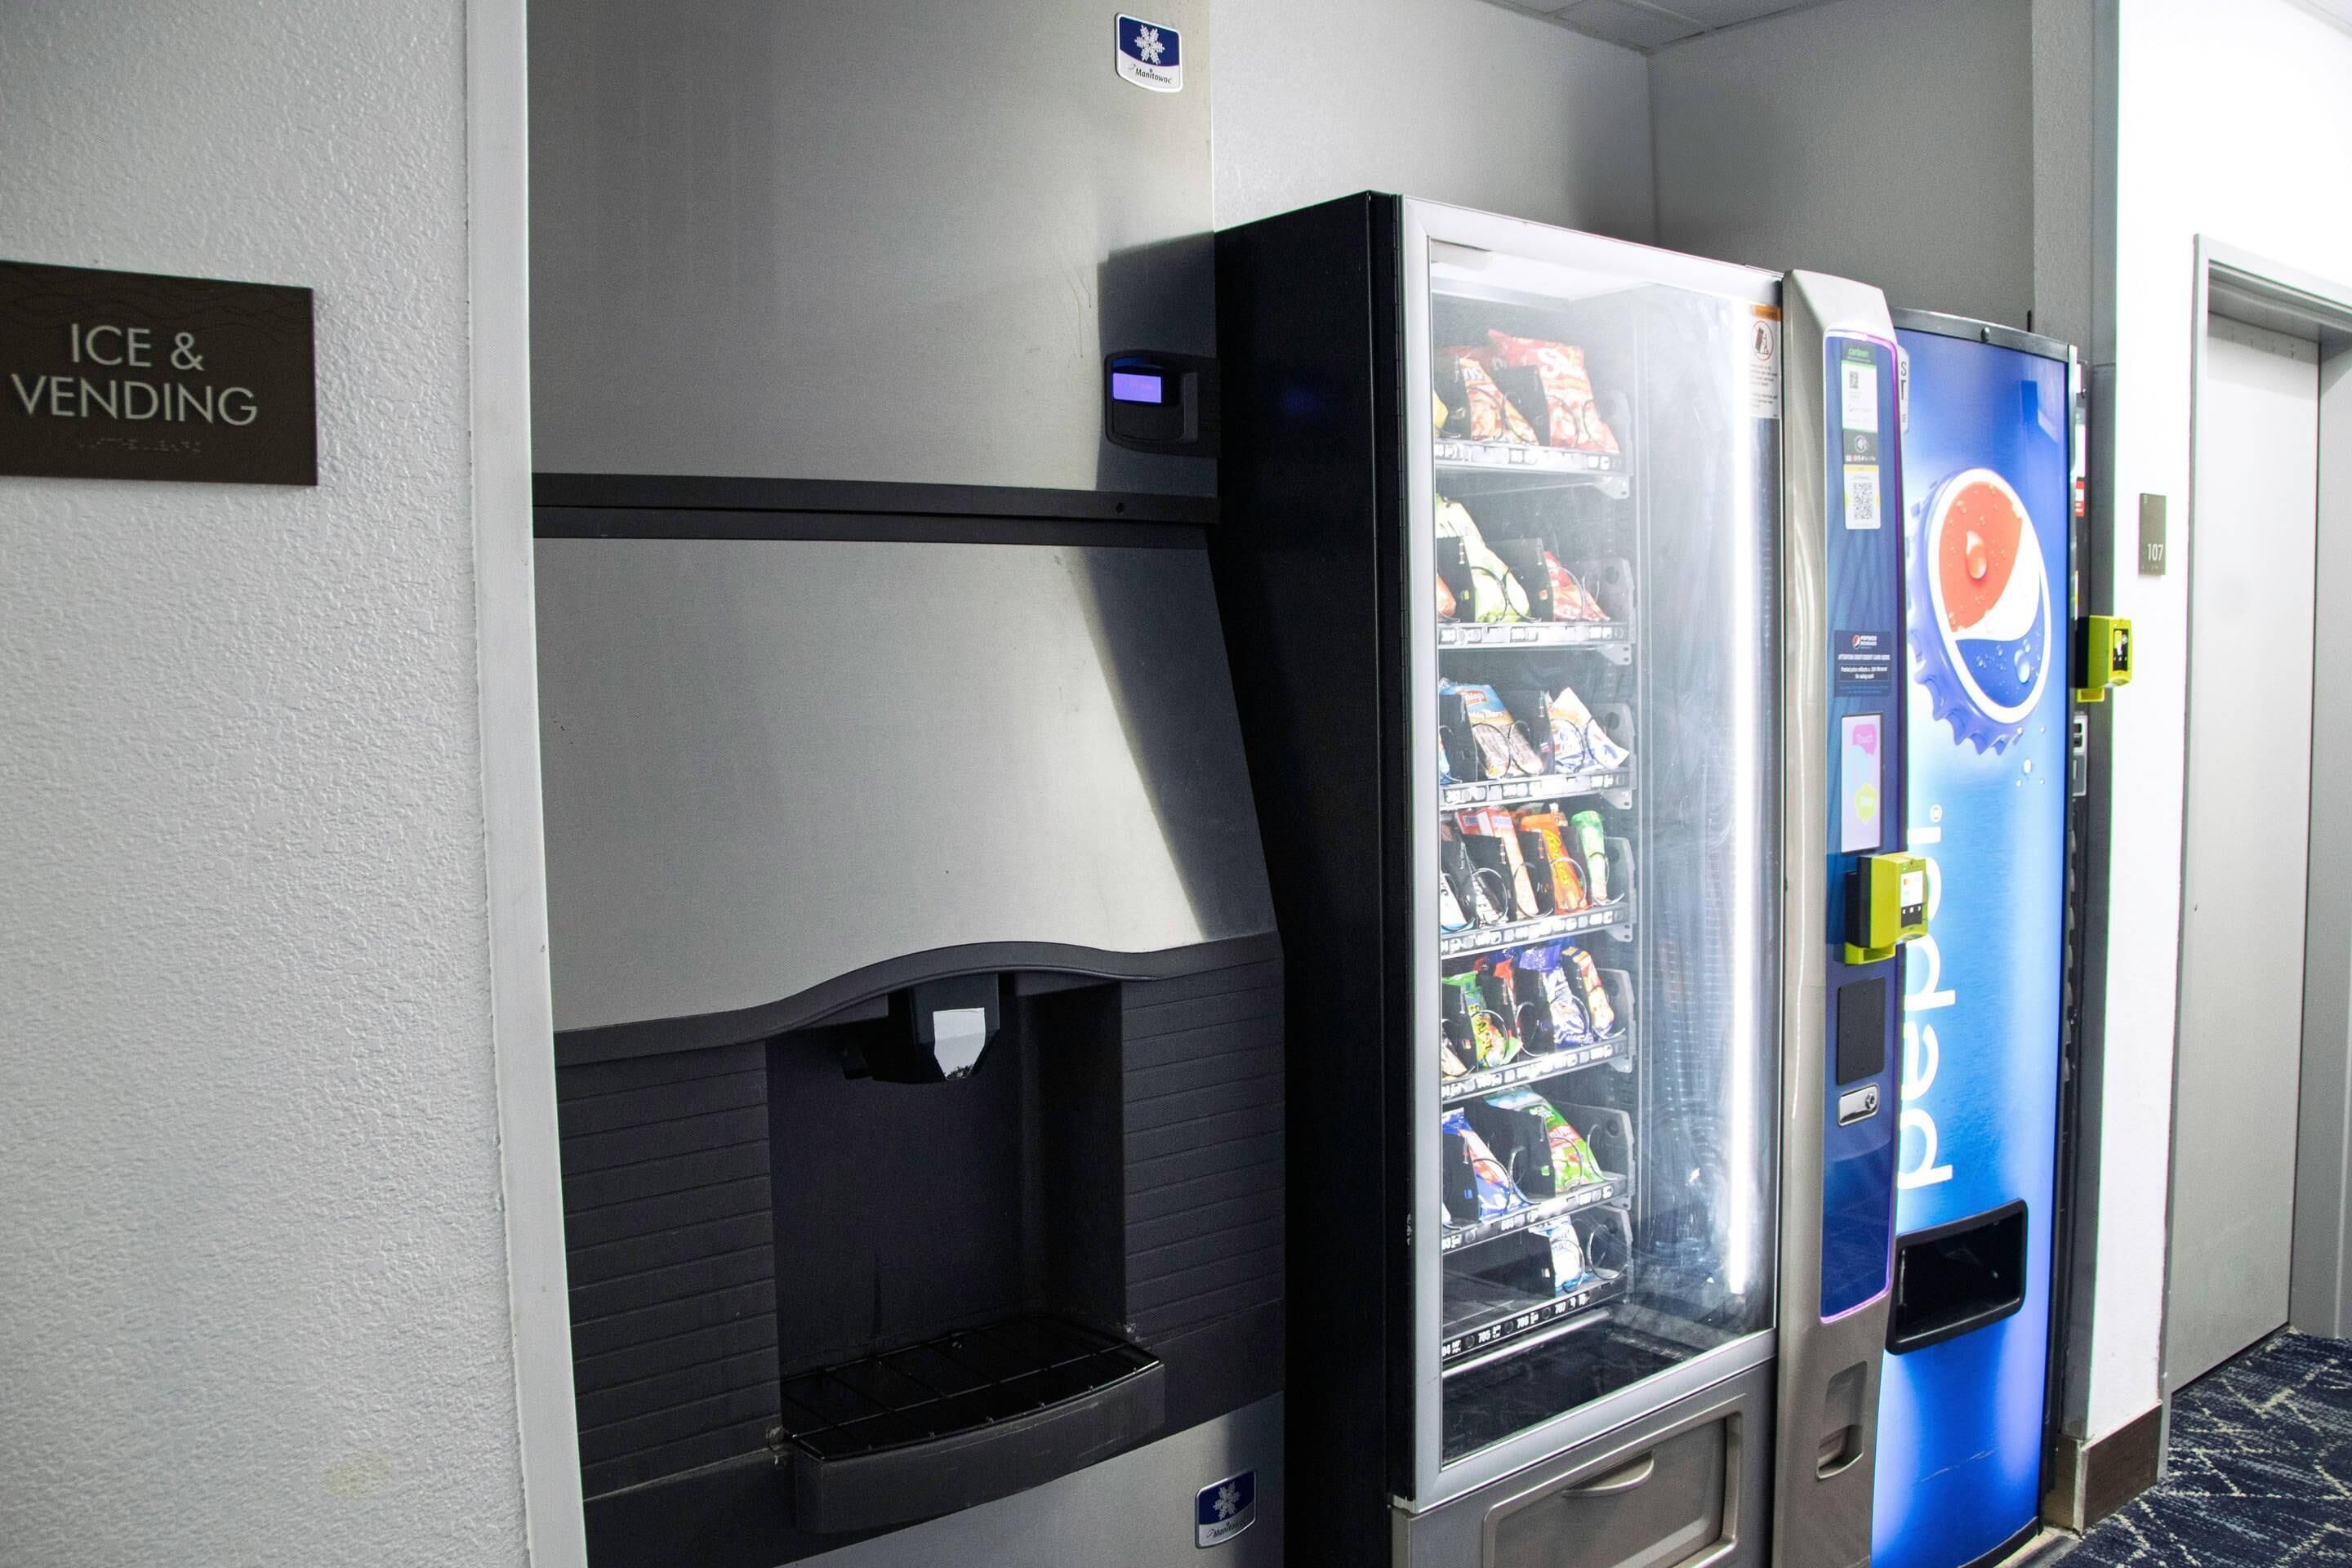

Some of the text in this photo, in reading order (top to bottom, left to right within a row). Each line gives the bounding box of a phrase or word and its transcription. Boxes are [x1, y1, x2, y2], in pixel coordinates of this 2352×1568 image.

[1135, 67, 1172, 84] Manitowoc
[71, 323, 205, 371] ICE &
[11, 372, 257, 426] VENDING
[2147, 542, 2164, 562] 107
